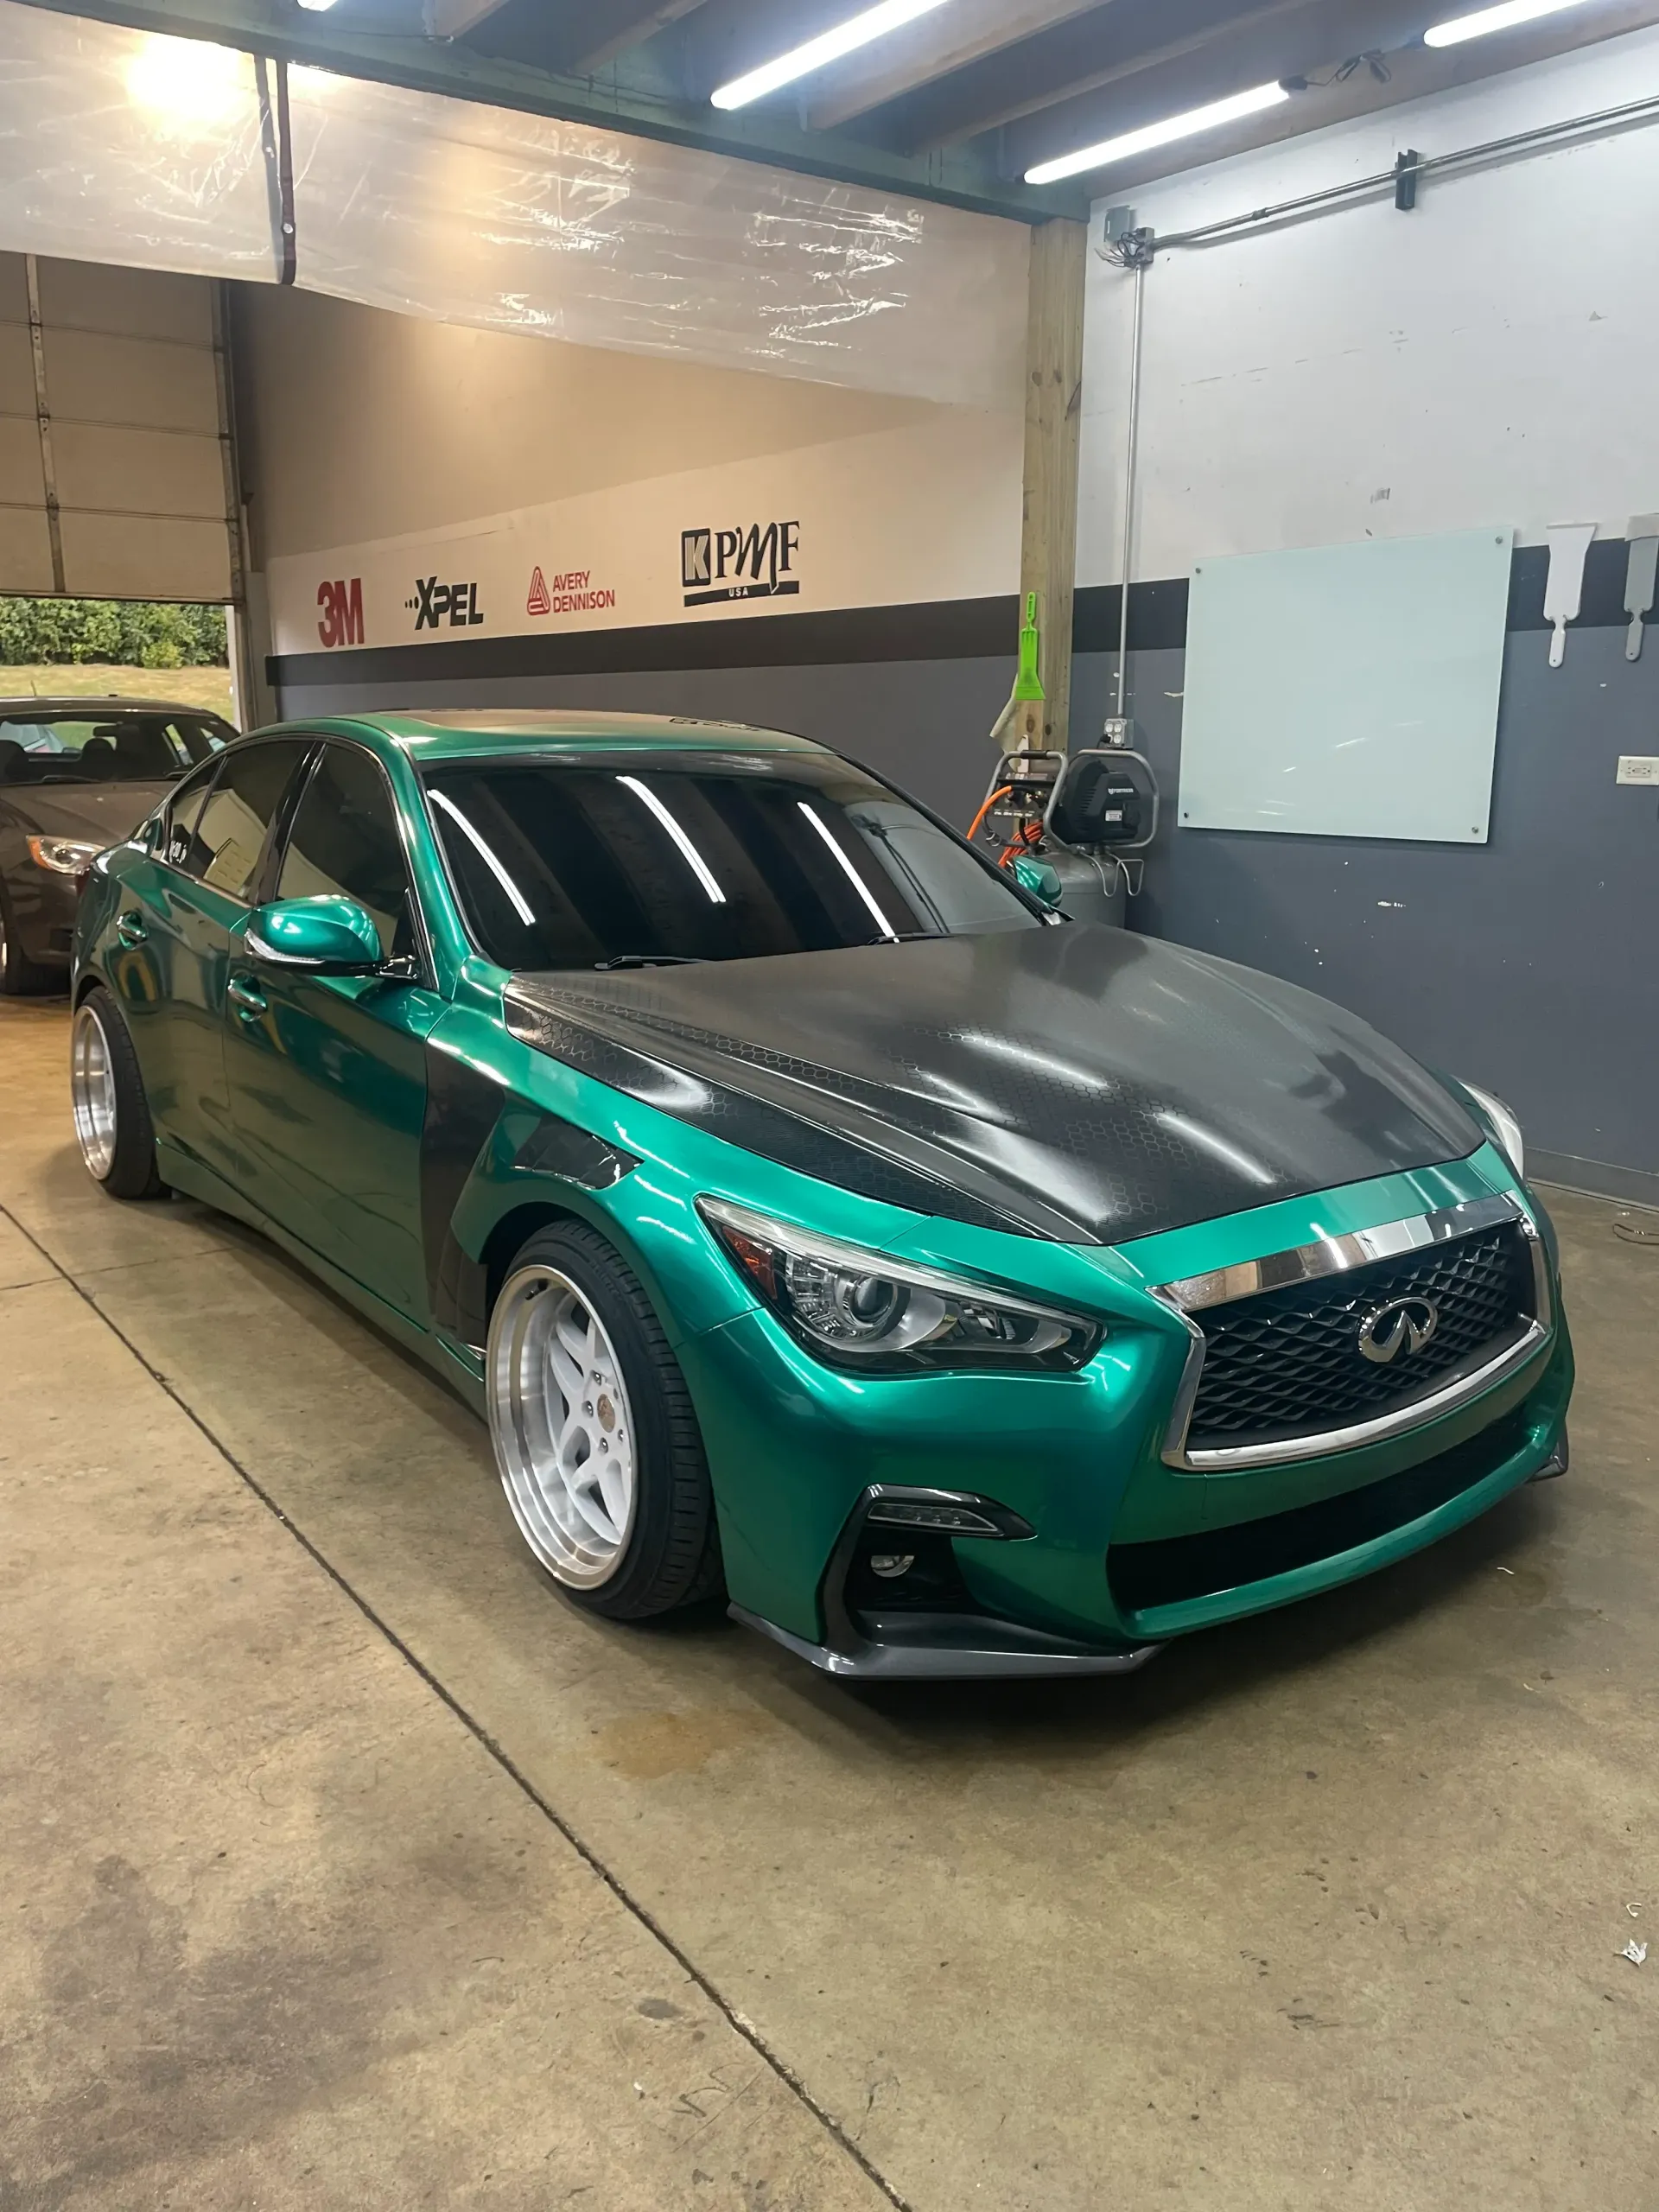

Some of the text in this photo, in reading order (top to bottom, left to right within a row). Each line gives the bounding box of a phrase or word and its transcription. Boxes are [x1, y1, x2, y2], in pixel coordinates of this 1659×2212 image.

[553, 570, 590, 592] AVERY
[728, 587, 749, 597] USA
[317, 578, 365, 648] 3M
[415, 575, 484, 630] XPEL
[553, 589, 615, 613] DENNISON
